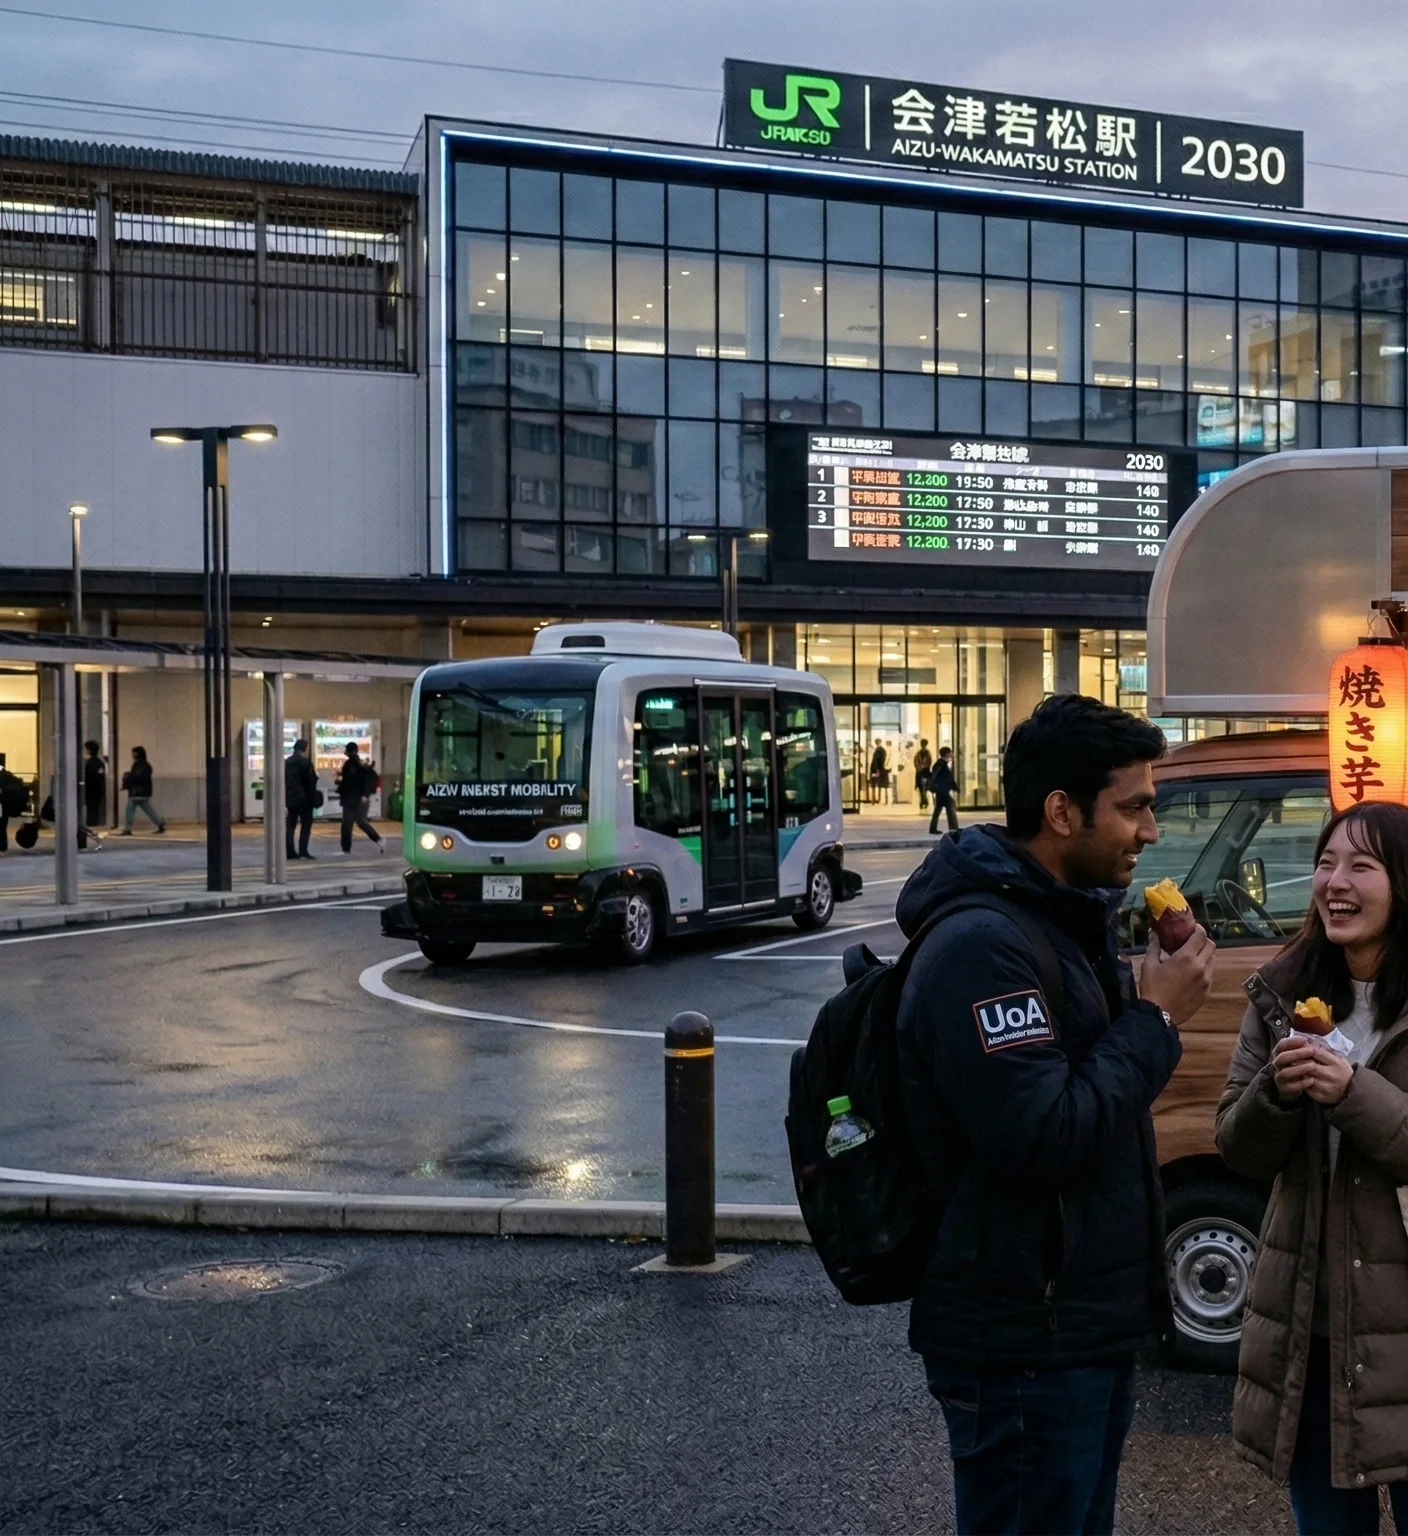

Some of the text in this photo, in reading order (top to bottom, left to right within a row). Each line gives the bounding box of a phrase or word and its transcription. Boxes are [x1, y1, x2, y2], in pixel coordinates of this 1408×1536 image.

[750, 74, 840, 128] JR
[891, 88, 1287, 186] 会津若松駅 2030
[891, 137, 1138, 182] AIZU-WAKAMATSU STATION
[817, 468, 826, 482] 1
[1125, 452, 1165, 471] 2030
[817, 490, 827, 503] 2
[1338, 664, 1386, 803] 焼き芋
[980, 997, 1047, 1034] UoA
